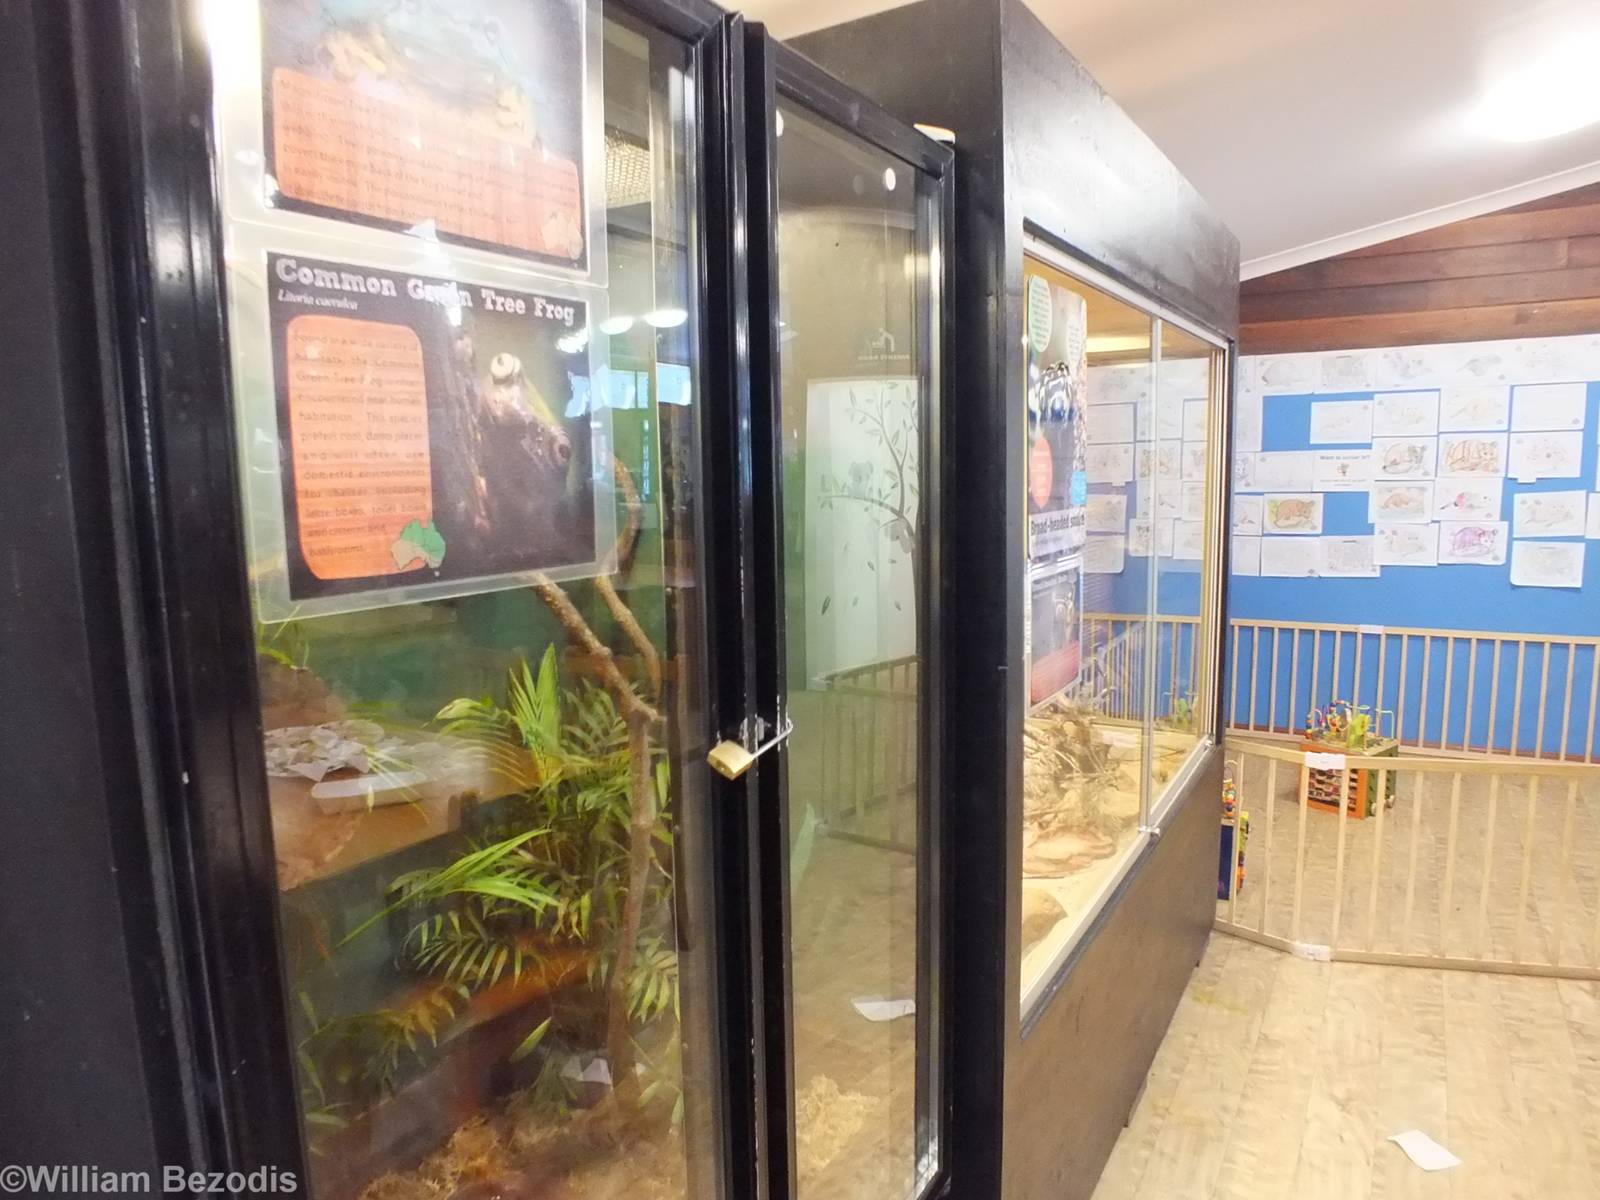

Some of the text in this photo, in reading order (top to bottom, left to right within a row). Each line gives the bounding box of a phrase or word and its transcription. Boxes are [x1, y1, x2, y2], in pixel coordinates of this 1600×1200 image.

[275, 257, 398, 297] Common
[481, 288, 526, 315] Tree
[533, 297, 575, 326] Frog
